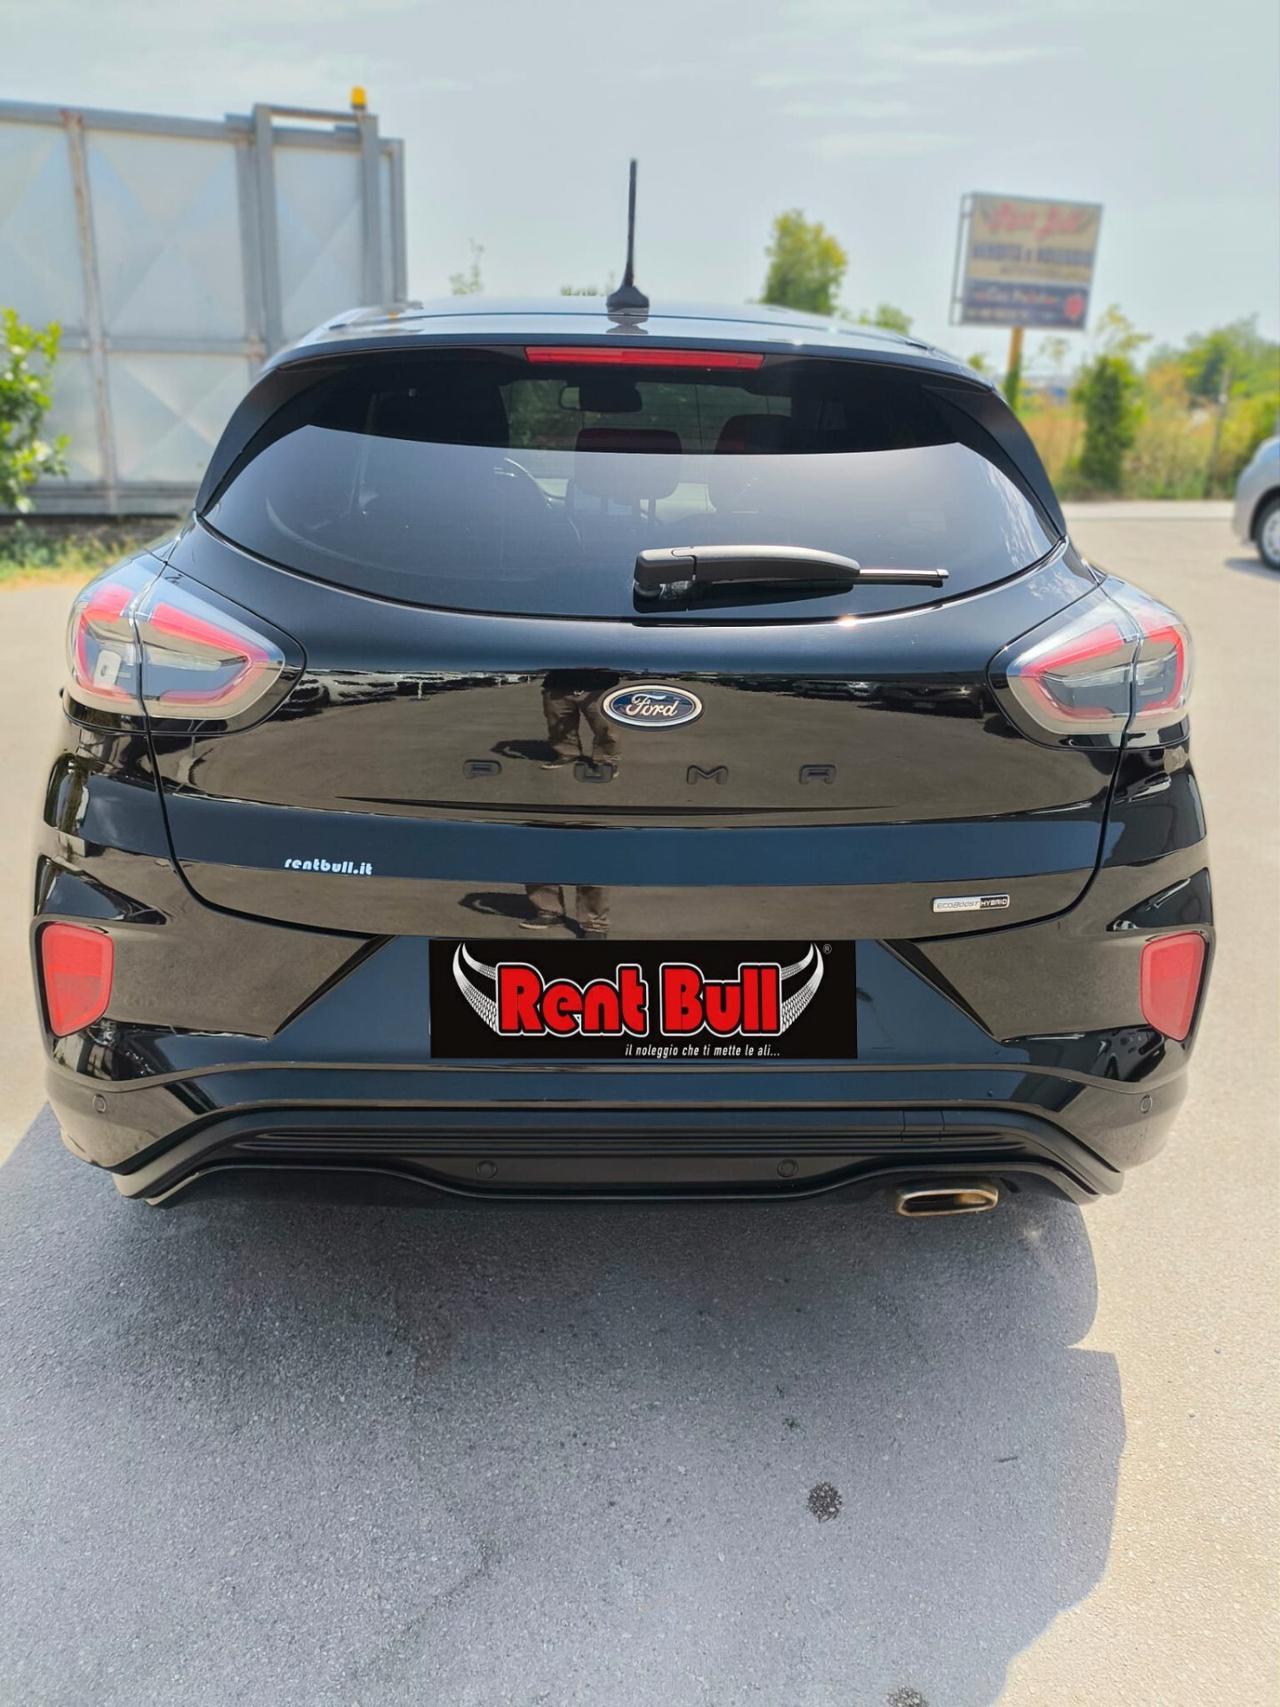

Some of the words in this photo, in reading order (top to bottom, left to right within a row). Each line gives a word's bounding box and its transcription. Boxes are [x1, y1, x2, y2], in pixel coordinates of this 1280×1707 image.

[625, 693, 680, 717] Ford
[463, 759, 838, 786] PUMA
[284, 858, 373, 876] rentbull.it
